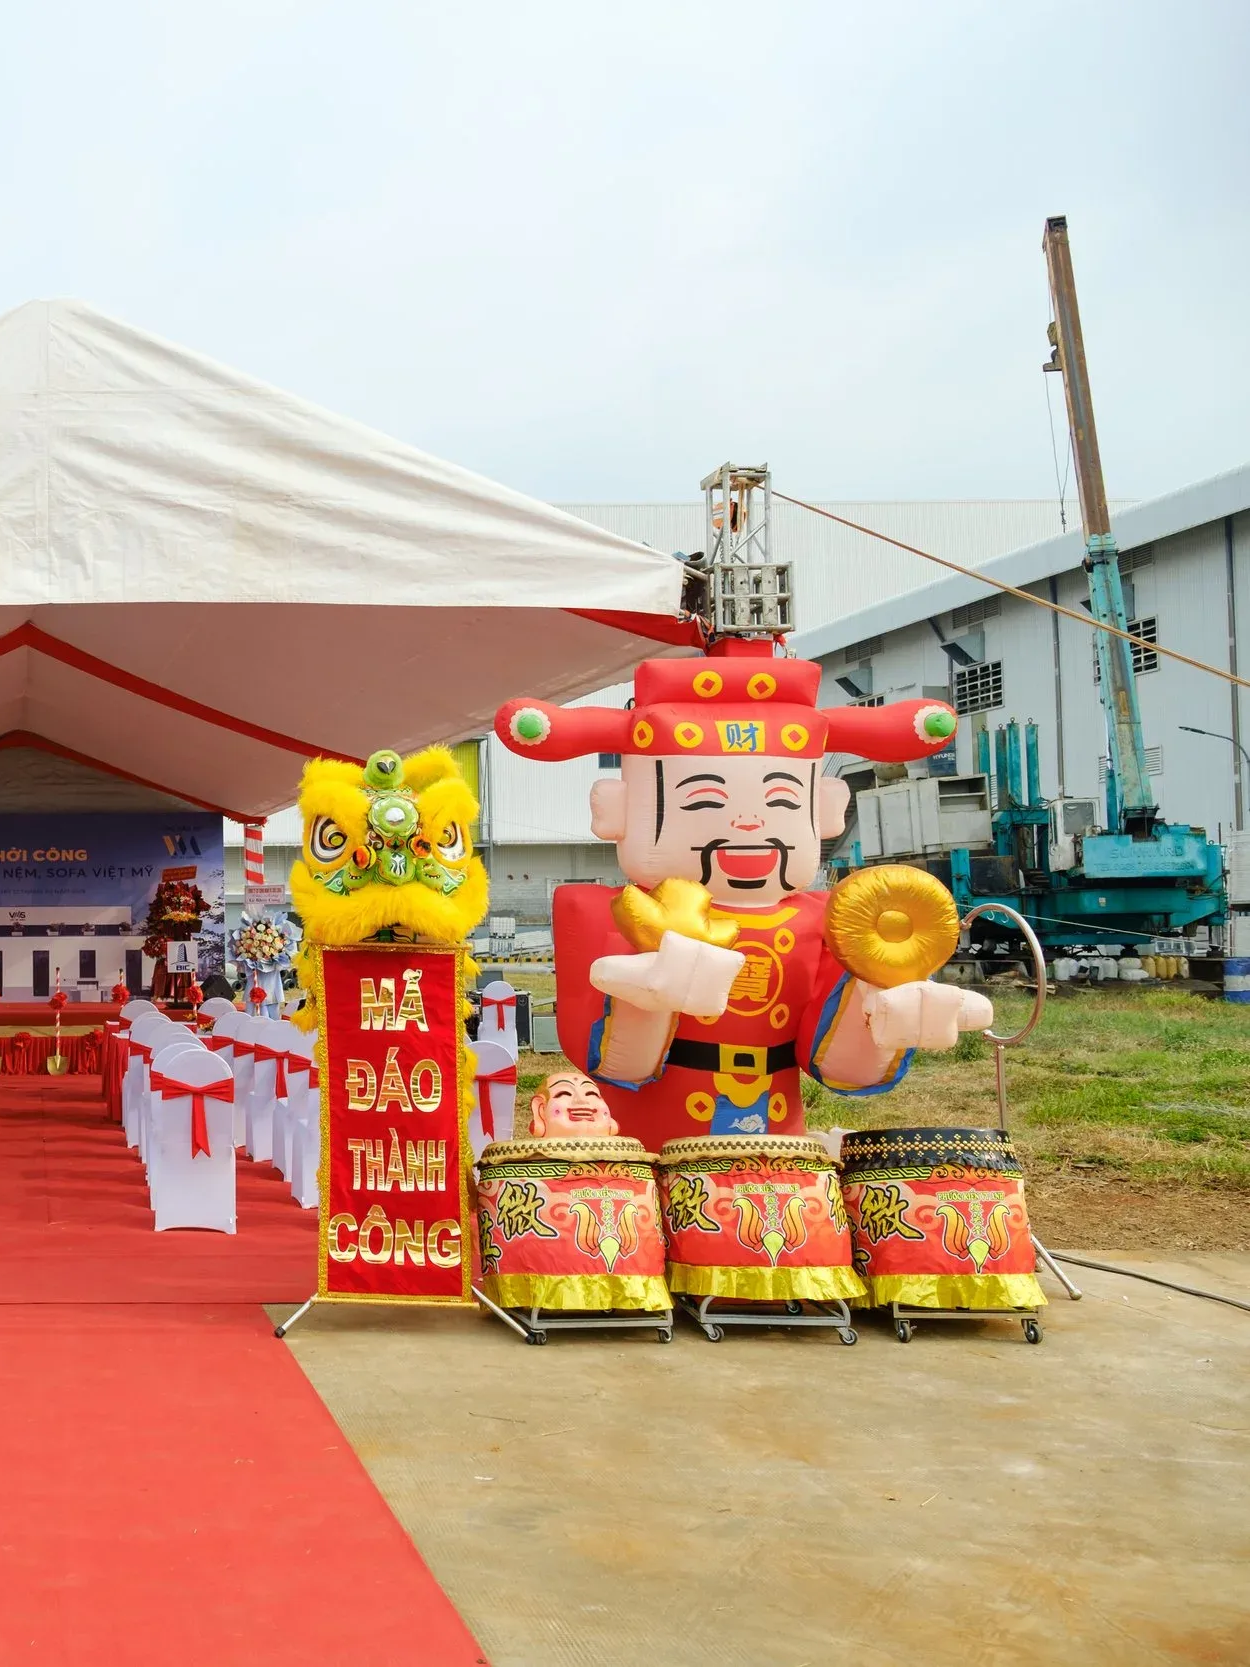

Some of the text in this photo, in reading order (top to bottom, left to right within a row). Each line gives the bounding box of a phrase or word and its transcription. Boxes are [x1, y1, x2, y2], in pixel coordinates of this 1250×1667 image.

[726, 723, 759, 752] 财
[33, 847, 88, 862] CÔNG
[46, 868, 86, 879] SOFA
[92, 865, 126, 880] VIỆT
[360, 968, 429, 1032] MÃ
[345, 1047, 443, 1113] ĐÁO
[348, 1127, 446, 1193] THÀNH
[328, 1204, 462, 1267] CÔNG
